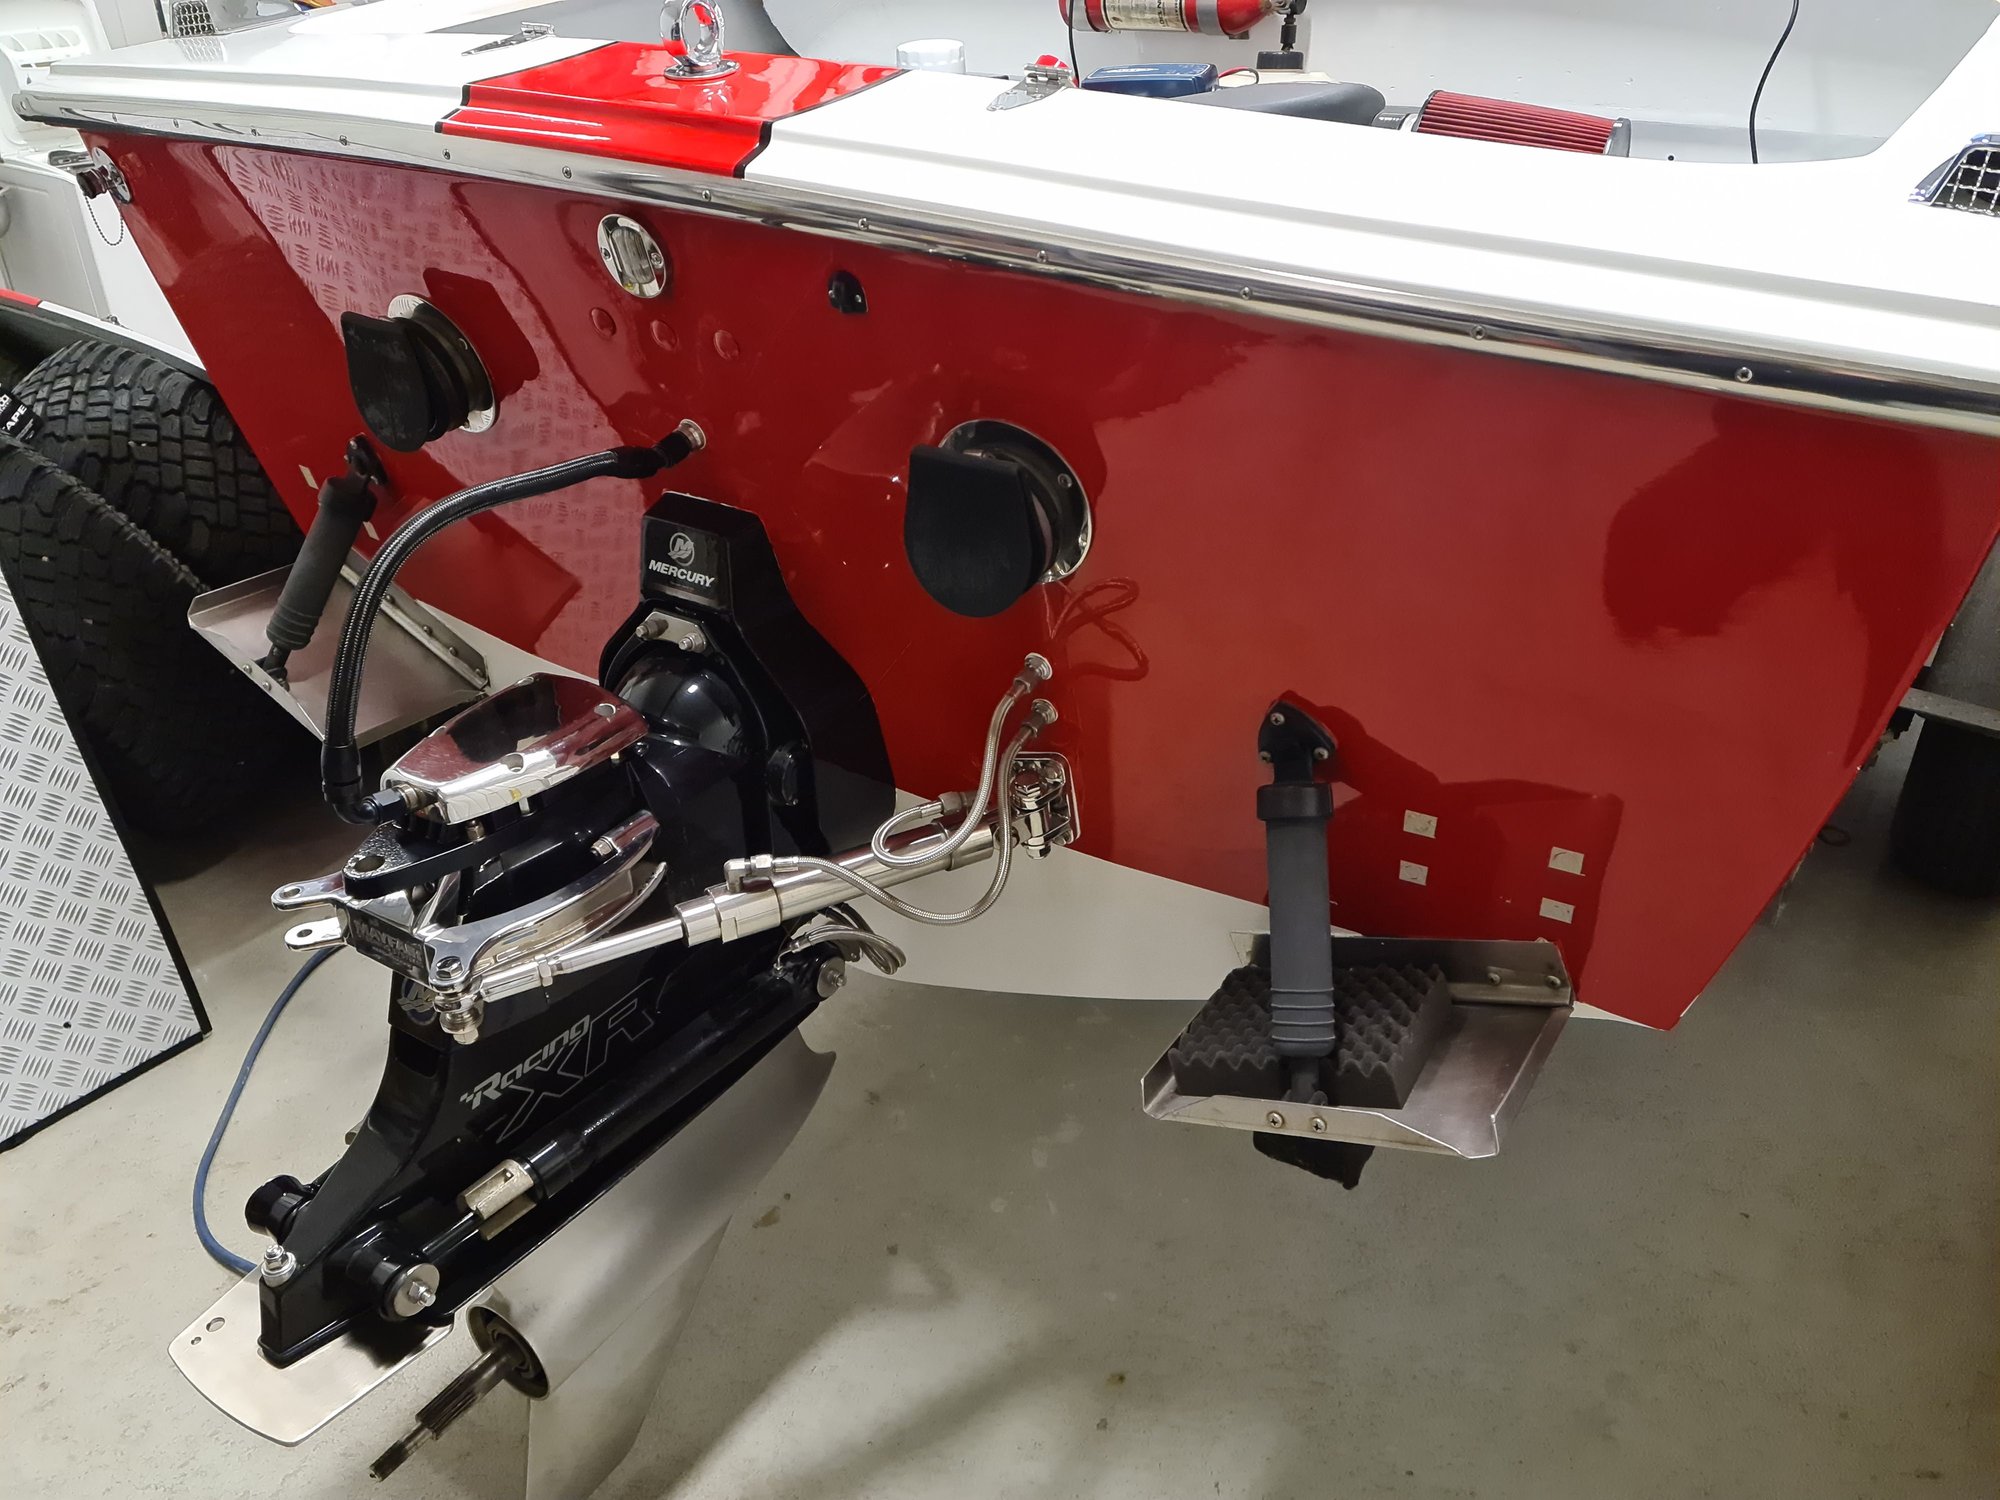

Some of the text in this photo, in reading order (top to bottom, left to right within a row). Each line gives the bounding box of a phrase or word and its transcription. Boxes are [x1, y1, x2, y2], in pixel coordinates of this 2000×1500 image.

[2, 404, 28, 431] APE
[648, 559, 715, 587] MERCURY
[460, 1014, 591, 1110] Racing
[496, 977, 654, 1144] XR
